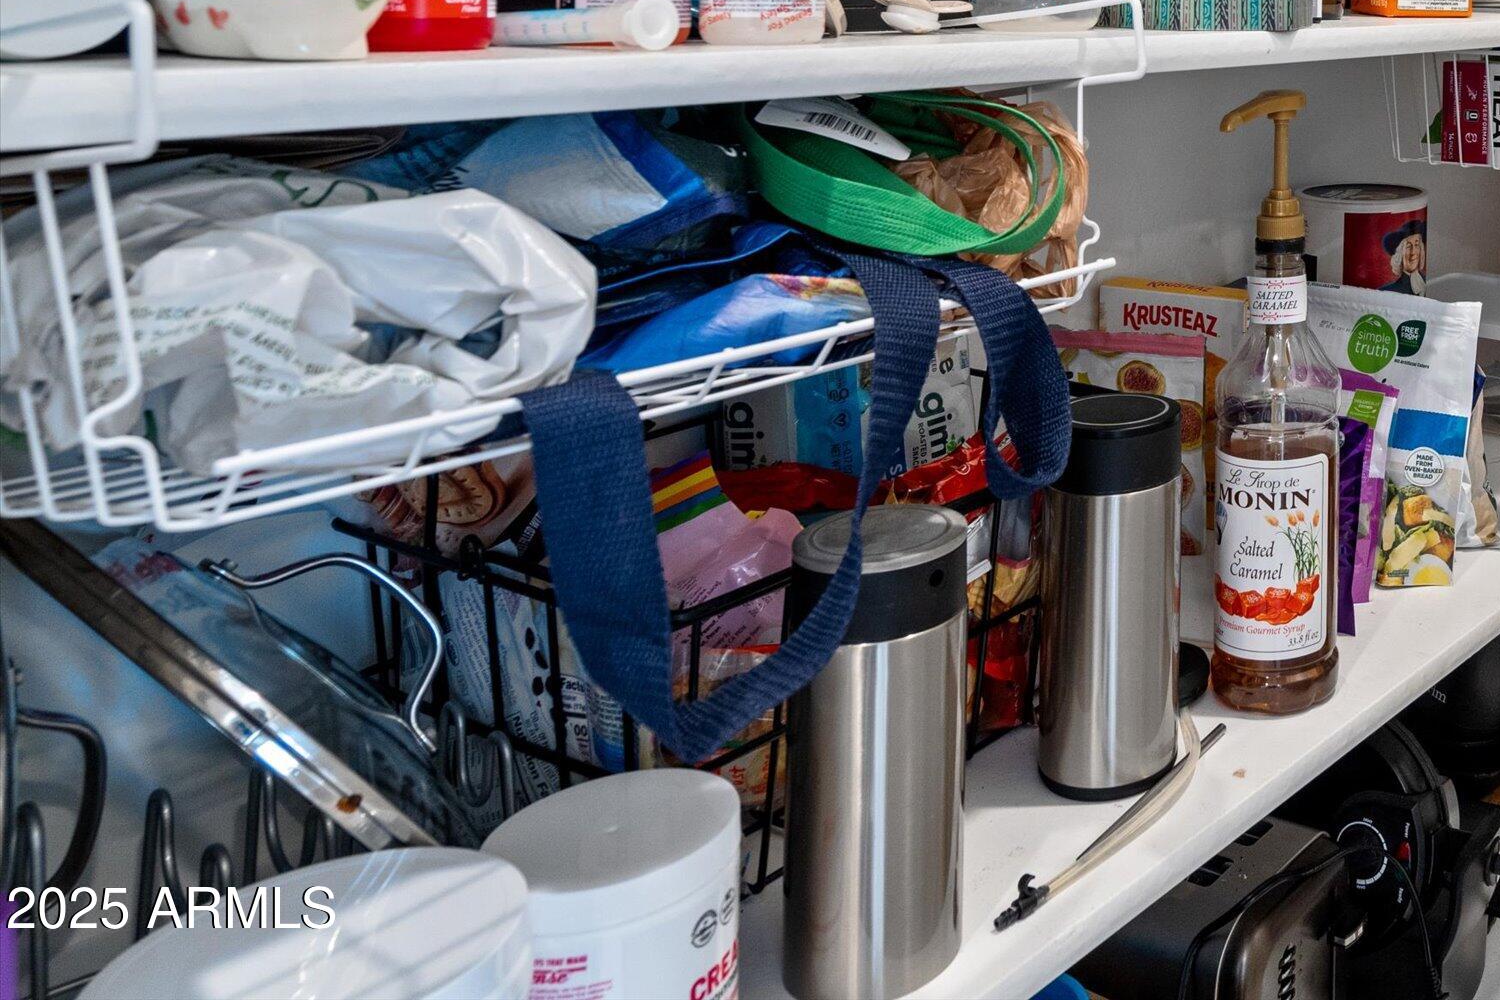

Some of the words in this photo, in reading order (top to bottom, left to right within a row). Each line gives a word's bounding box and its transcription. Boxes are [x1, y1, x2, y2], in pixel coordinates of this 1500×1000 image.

[1481, 104, 1489, 156] PERFORMANCE
[1256, 290, 1293, 300] SALTED
[1252, 299, 1298, 310] CARAMEL
[1123, 301, 1219, 338] KRUSTEAZ
[1400, 325, 1420, 335] FREE
[1400, 331, 1420, 342] FROM
[1356, 329, 1392, 347] simple
[1355, 340, 1389, 359] truth
[1415, 460, 1433, 468] FROM
[1416, 453, 1434, 462] MADE
[1404, 465, 1443, 475] OVEN-BAKED
[1412, 472, 1434, 480] BREAD
[1225, 467, 1242, 486] Le
[1244, 470, 1281, 493] Sirop
[1284, 476, 1300, 488] de
[1219, 481, 1311, 512] MONIN
[1237, 535, 1275, 559] Salted
[1229, 551, 1284, 581] Caramel
[1218, 617, 1245, 634] Premium
[1246, 624, 1281, 636] Gourmet
[1281, 622, 1306, 640] Syrup
[1287, 635, 1304, 648] 33.8
